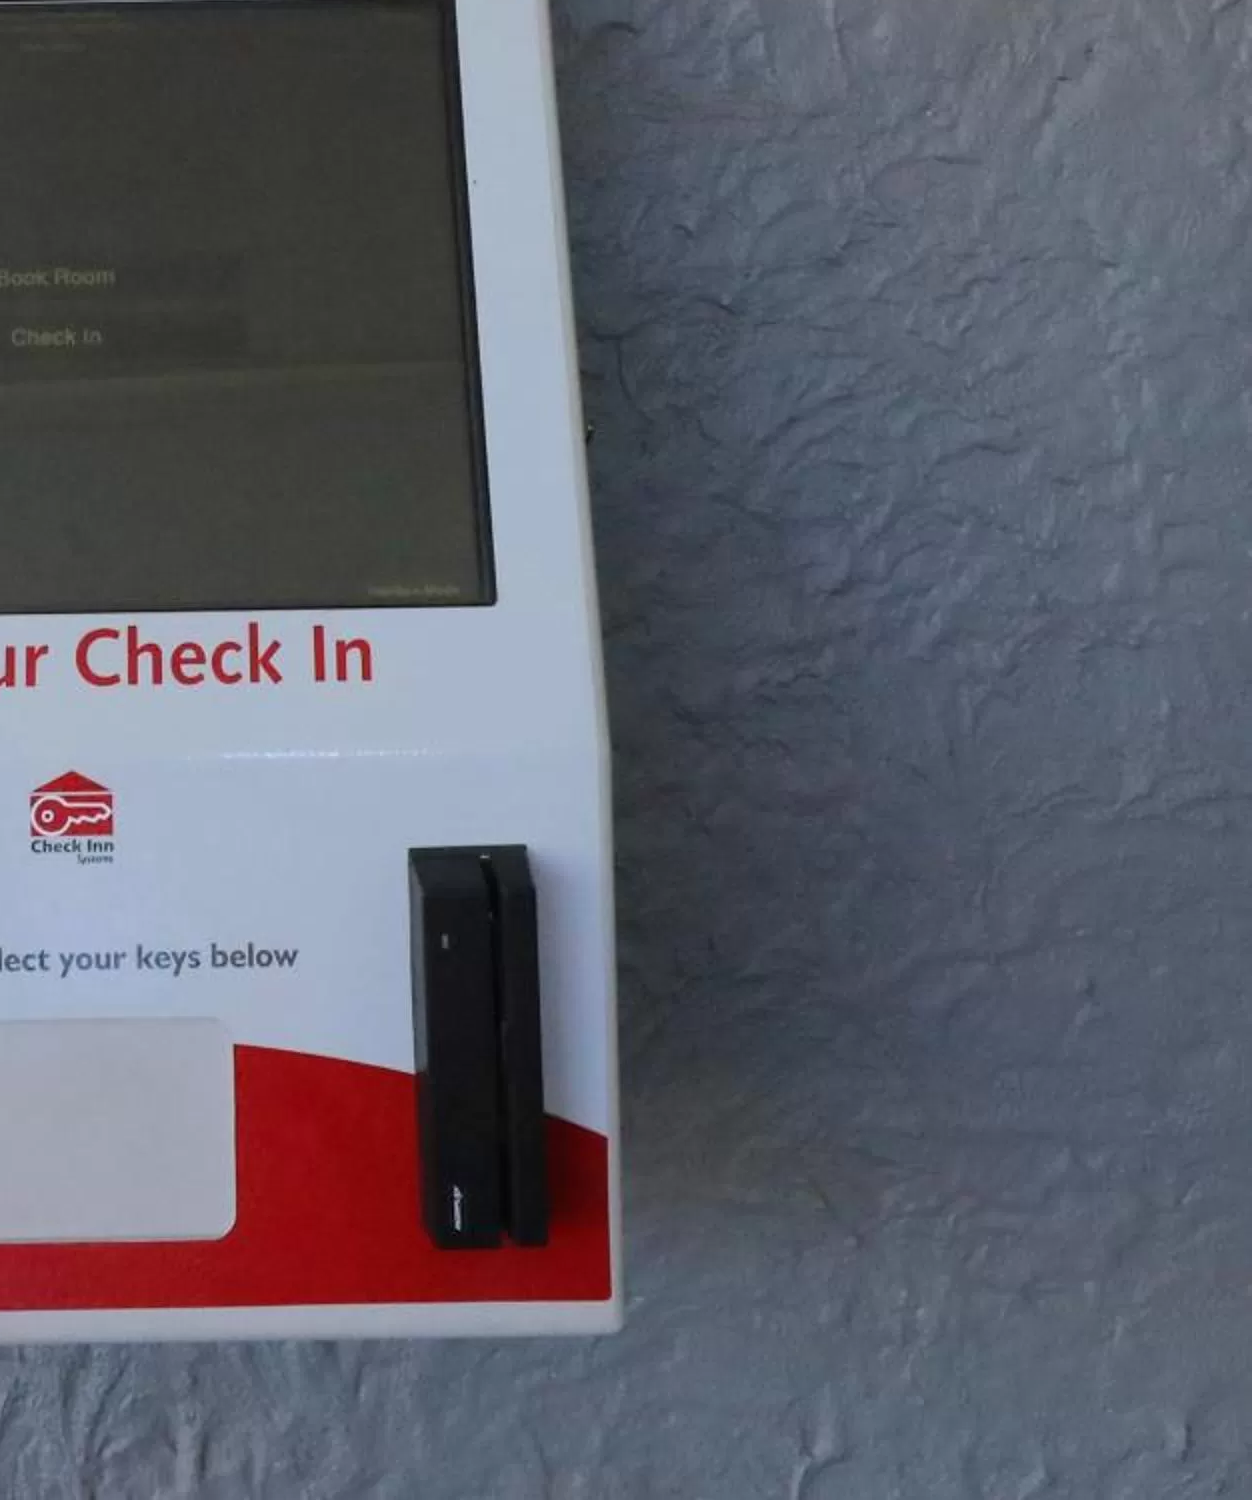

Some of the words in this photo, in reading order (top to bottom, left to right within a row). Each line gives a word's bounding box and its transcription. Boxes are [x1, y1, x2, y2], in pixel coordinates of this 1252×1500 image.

[54, 267, 116, 287] Room
[12, 327, 75, 346] Check
[83, 327, 102, 345] In
[75, 624, 283, 686] Check
[313, 624, 374, 681] In
[31, 839, 81, 853] Check
[86, 839, 114, 853] Inn
[60, 951, 126, 978] your
[137, 944, 201, 977] keys
[212, 942, 299, 969] below
